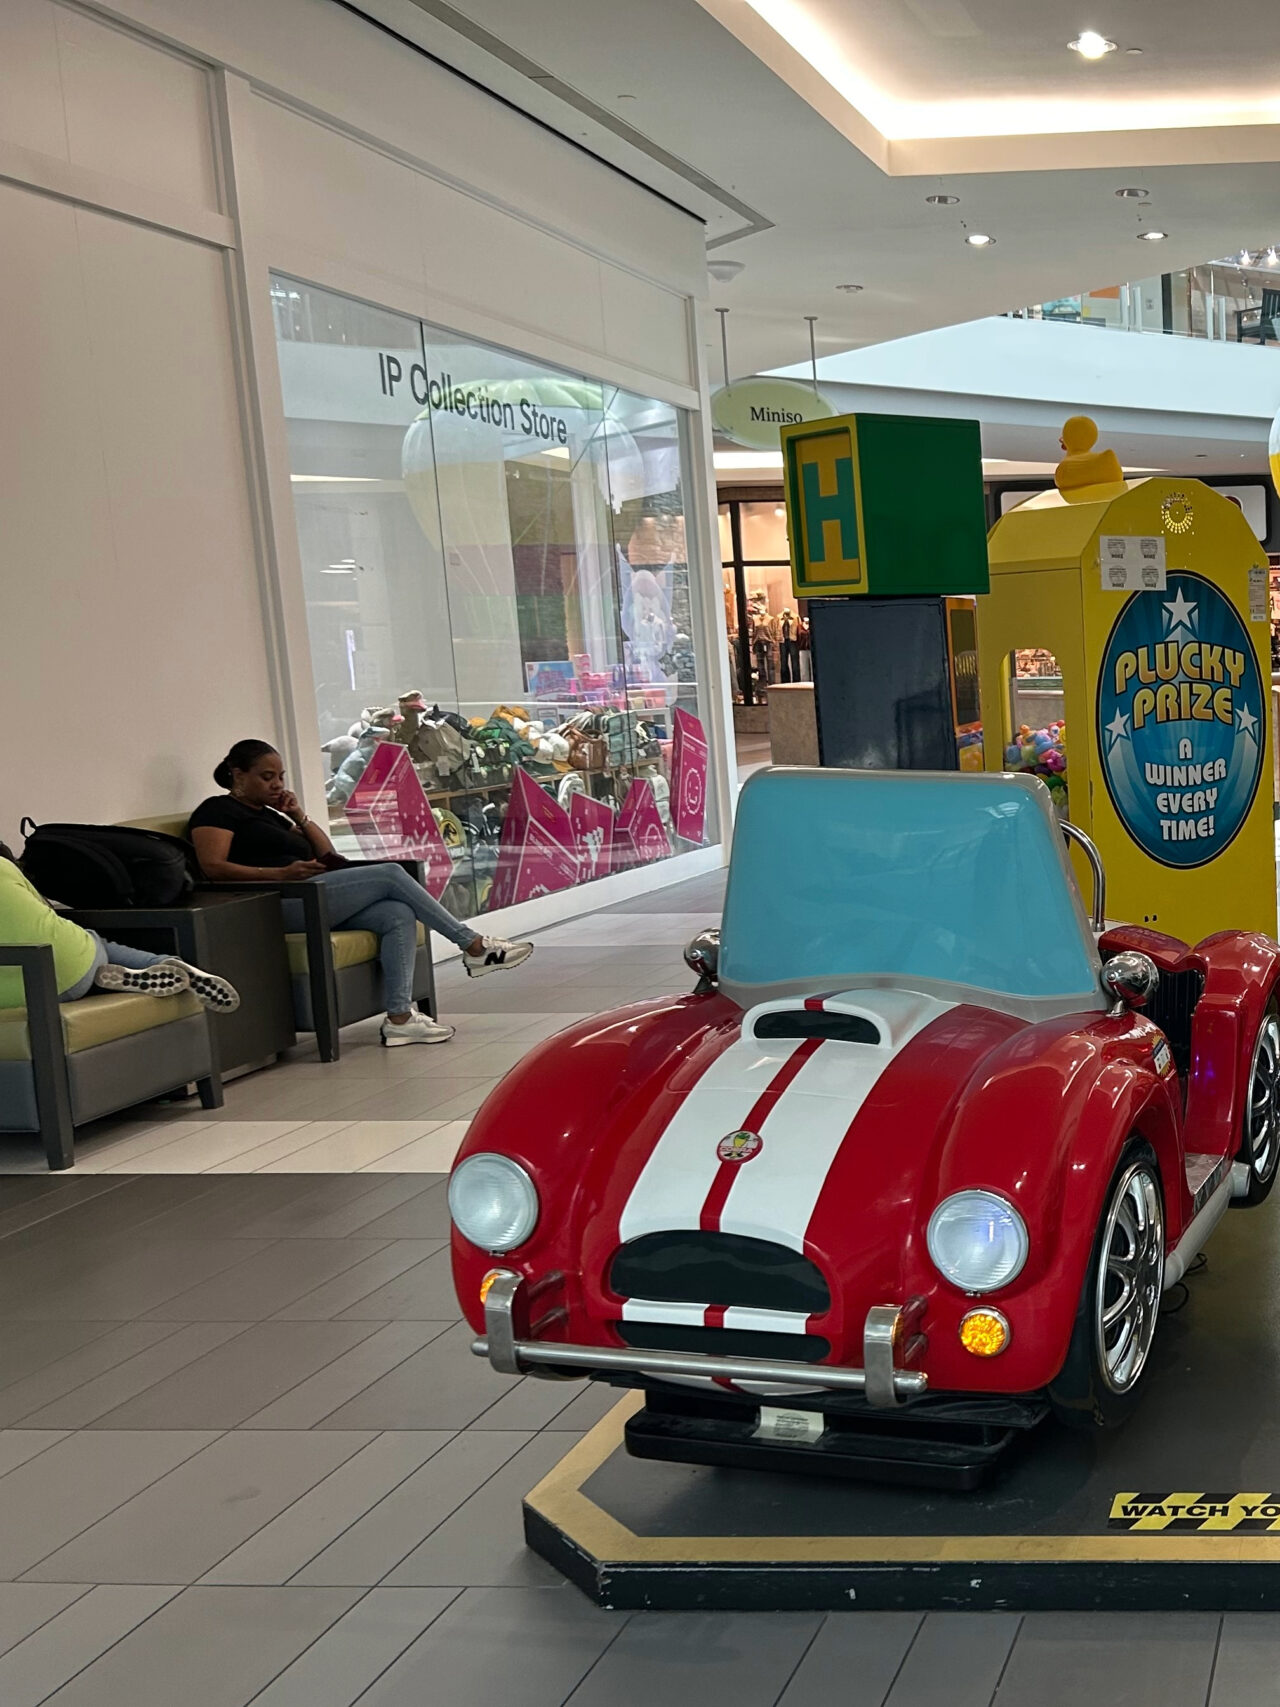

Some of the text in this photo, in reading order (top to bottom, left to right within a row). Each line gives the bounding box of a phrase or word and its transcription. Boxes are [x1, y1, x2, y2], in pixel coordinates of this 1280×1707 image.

[379, 352, 567, 444] IP Collection Store
[750, 406, 803, 424] Miniso
[803, 456, 859, 563] H
[1115, 642, 1245, 695] PLUCKY
[1133, 682, 1233, 729] PRIZE
[1179, 737, 1193, 759] A
[1145, 758, 1227, 786] WINNER
[1156, 787, 1219, 814] EVERY
[1160, 814, 1216, 841] TIME!
[1121, 1505, 1229, 1517] WATCH
